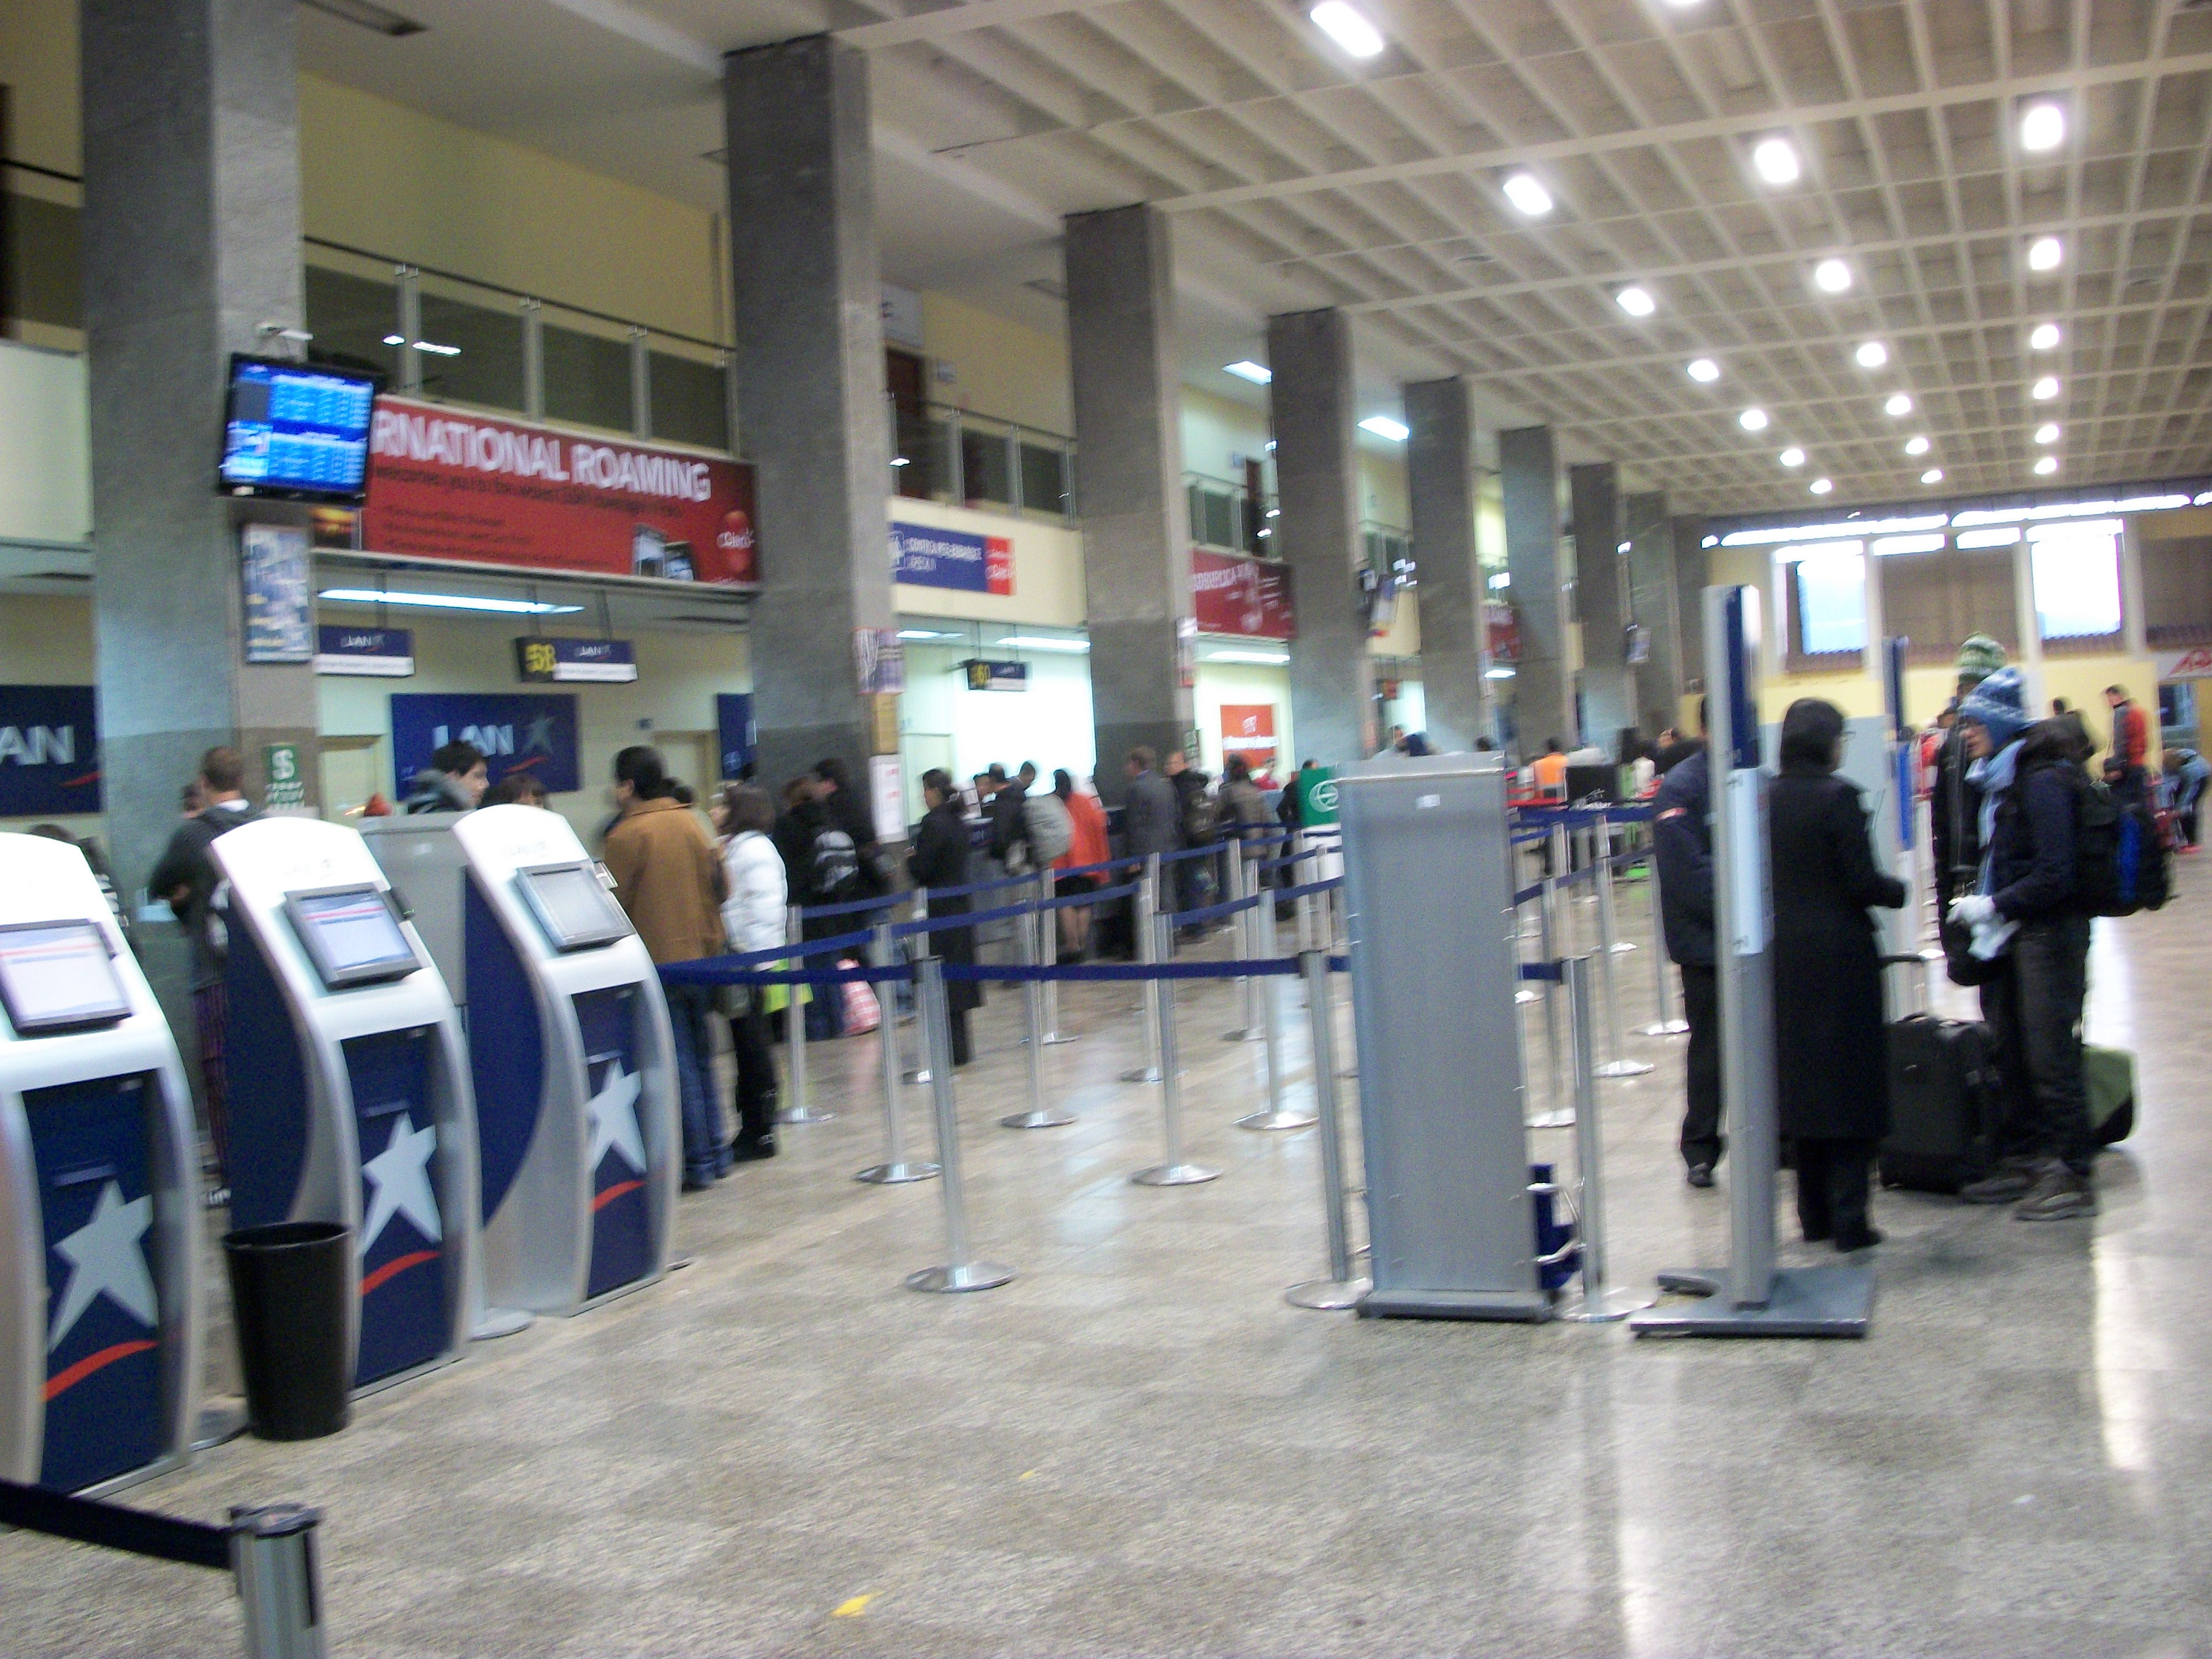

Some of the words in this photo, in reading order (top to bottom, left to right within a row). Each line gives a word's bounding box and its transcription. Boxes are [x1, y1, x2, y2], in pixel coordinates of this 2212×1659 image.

[369, 410, 570, 482] RNATIONAL
[570, 444, 711, 503] ROAMING
[341, 635, 372, 648] LAN
[575, 645, 602, 656] LAN
[272, 749, 295, 780] S
